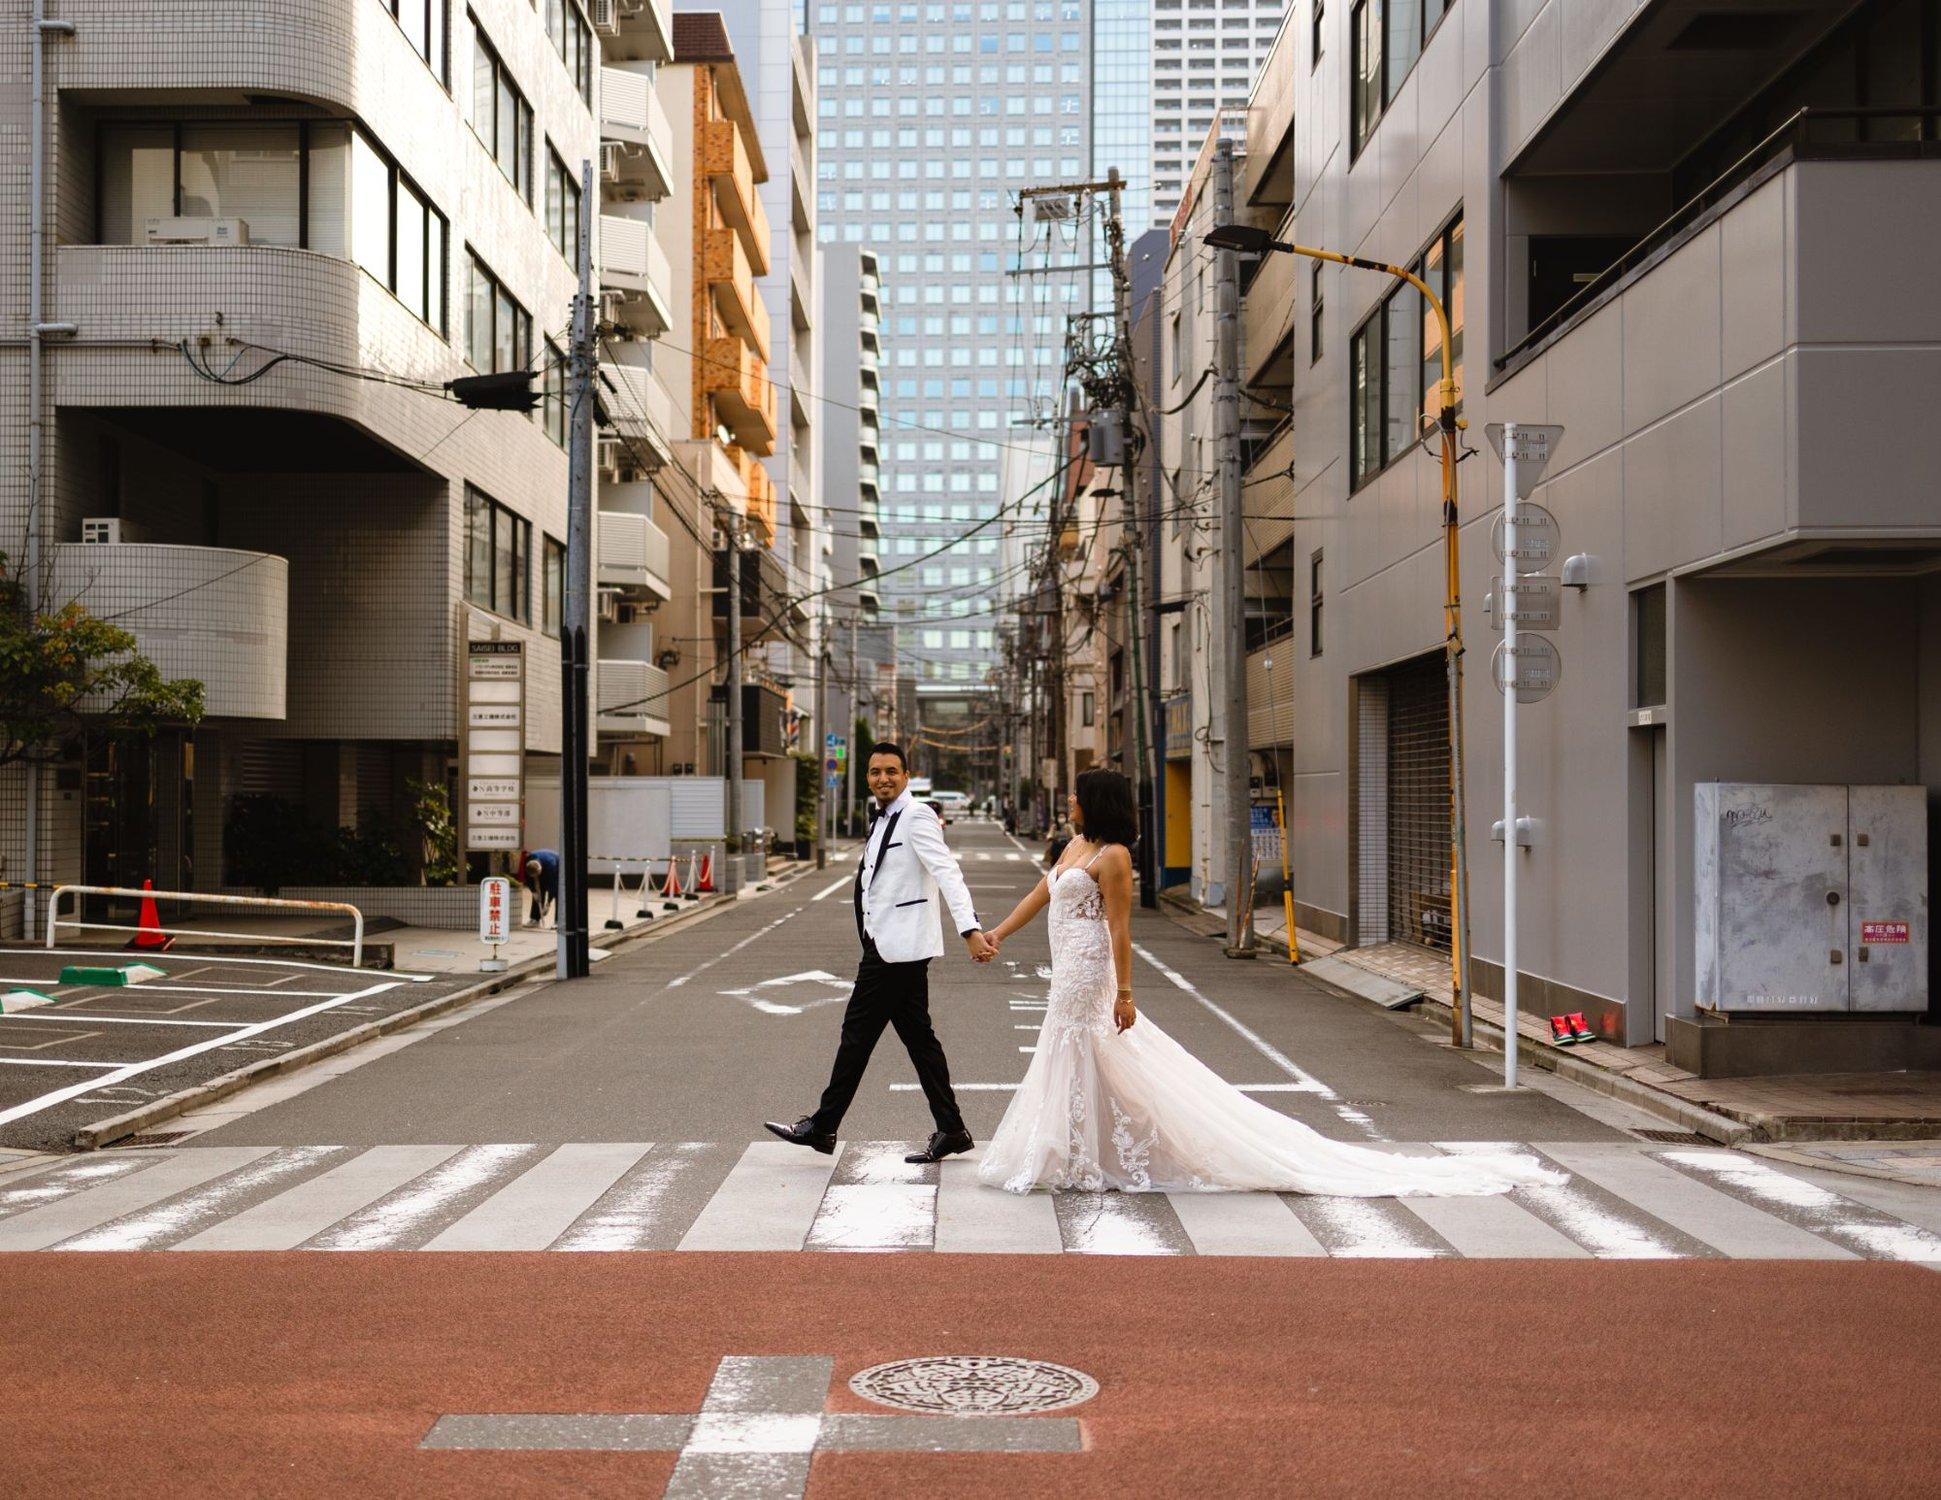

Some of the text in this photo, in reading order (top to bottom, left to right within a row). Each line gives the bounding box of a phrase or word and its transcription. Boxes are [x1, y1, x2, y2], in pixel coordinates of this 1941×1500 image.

[488, 881, 502, 936] 駐車禁止
[1864, 924, 1907, 934] 高圧危険
